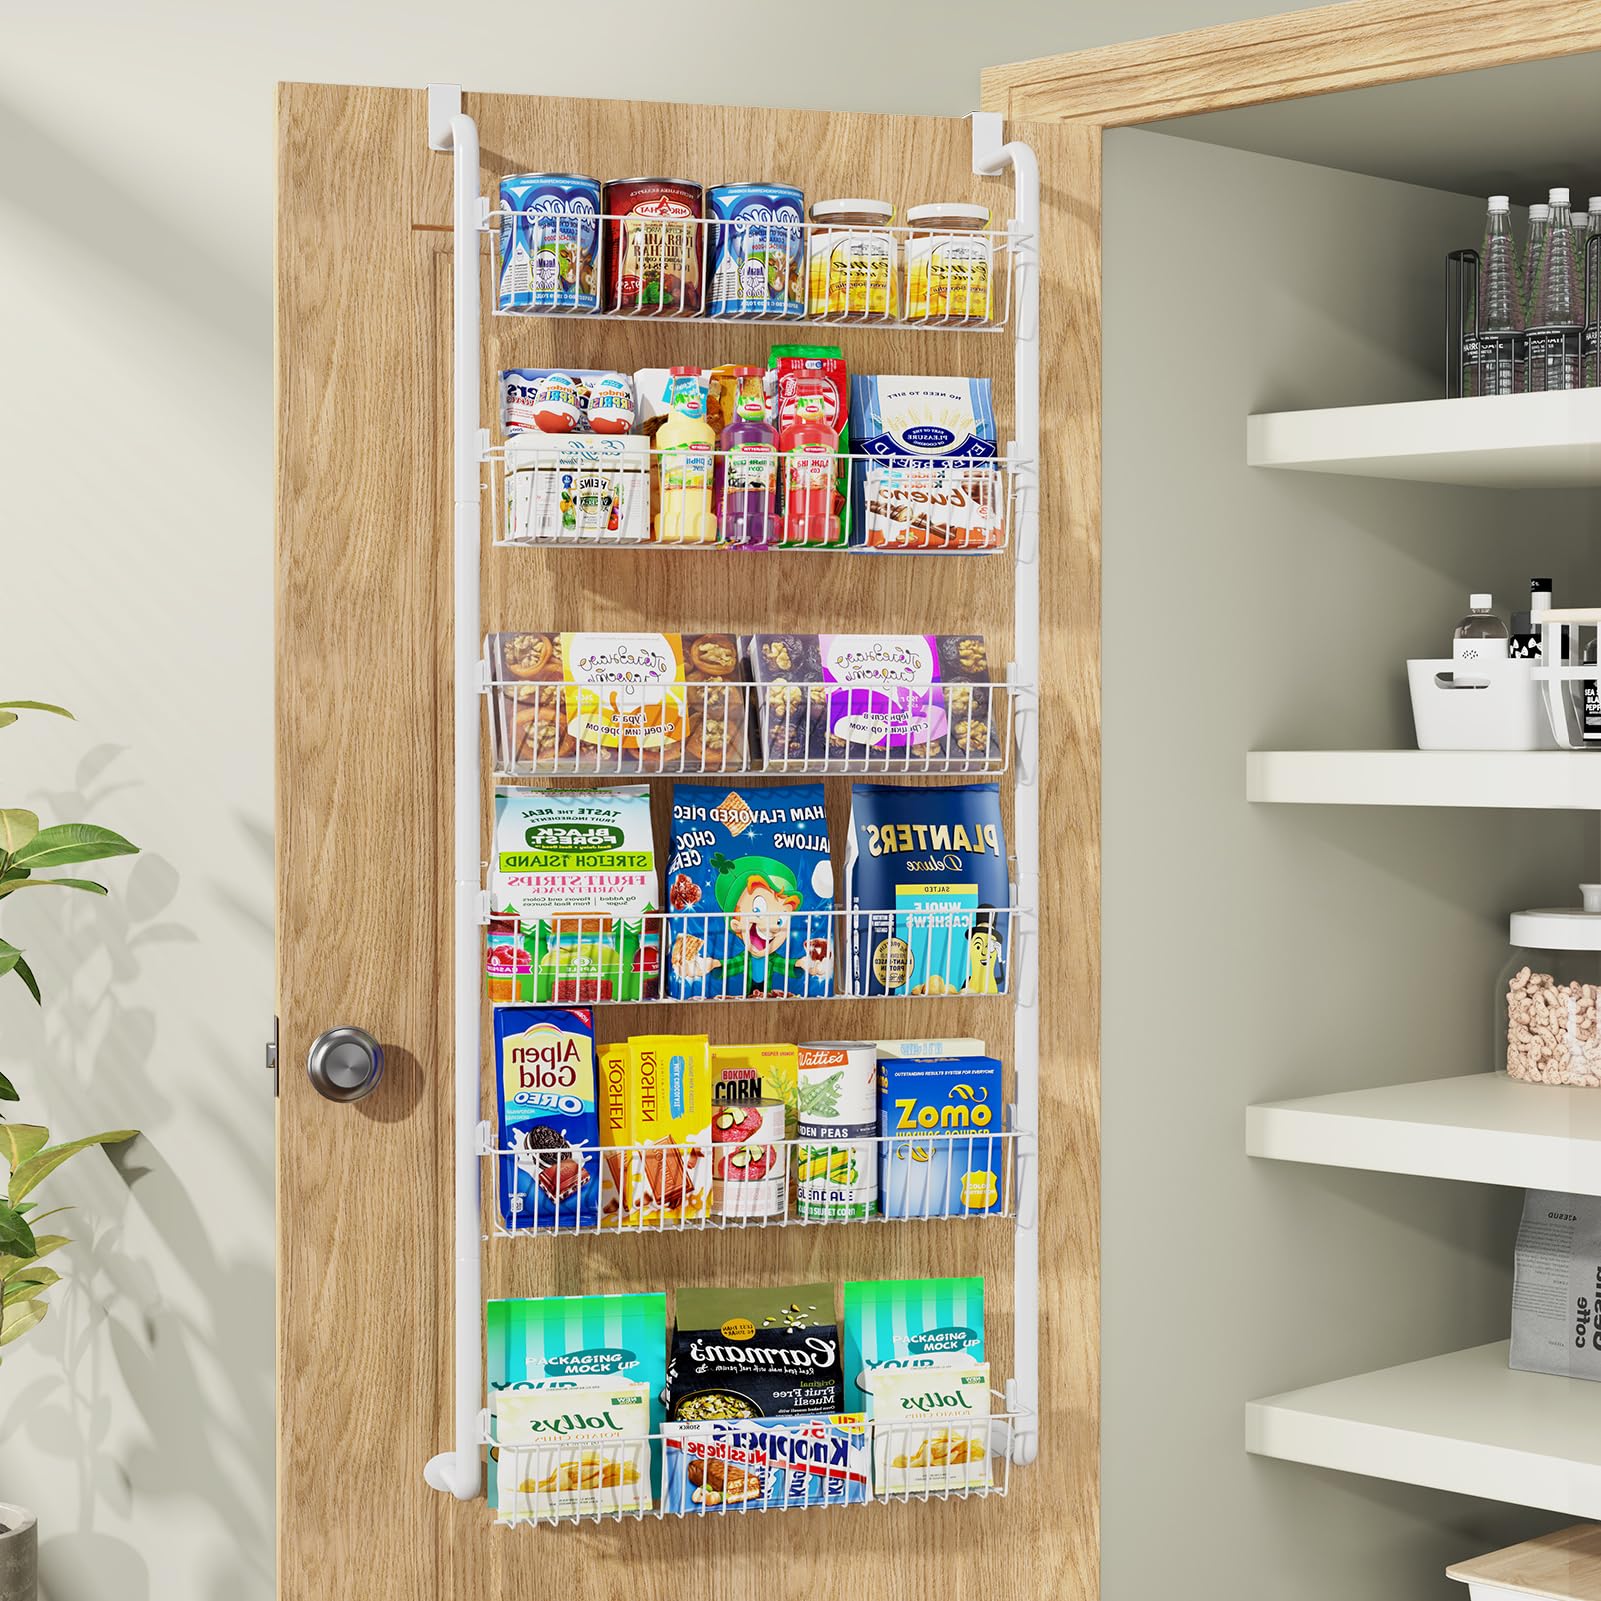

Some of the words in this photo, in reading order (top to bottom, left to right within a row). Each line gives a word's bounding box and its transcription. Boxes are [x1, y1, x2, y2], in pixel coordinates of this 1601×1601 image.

[722, 1070, 757, 1080] BOKOMO
[714, 1077, 762, 1101] CORN
[895, 1098, 993, 1129] Zomo
[821, 1128, 849, 1138] PEAS
[922, 1341, 958, 1352] MOCK
[961, 1339, 982, 1348] UP
[564, 1363, 612, 1374] MOCK
[618, 1361, 641, 1371] UP
